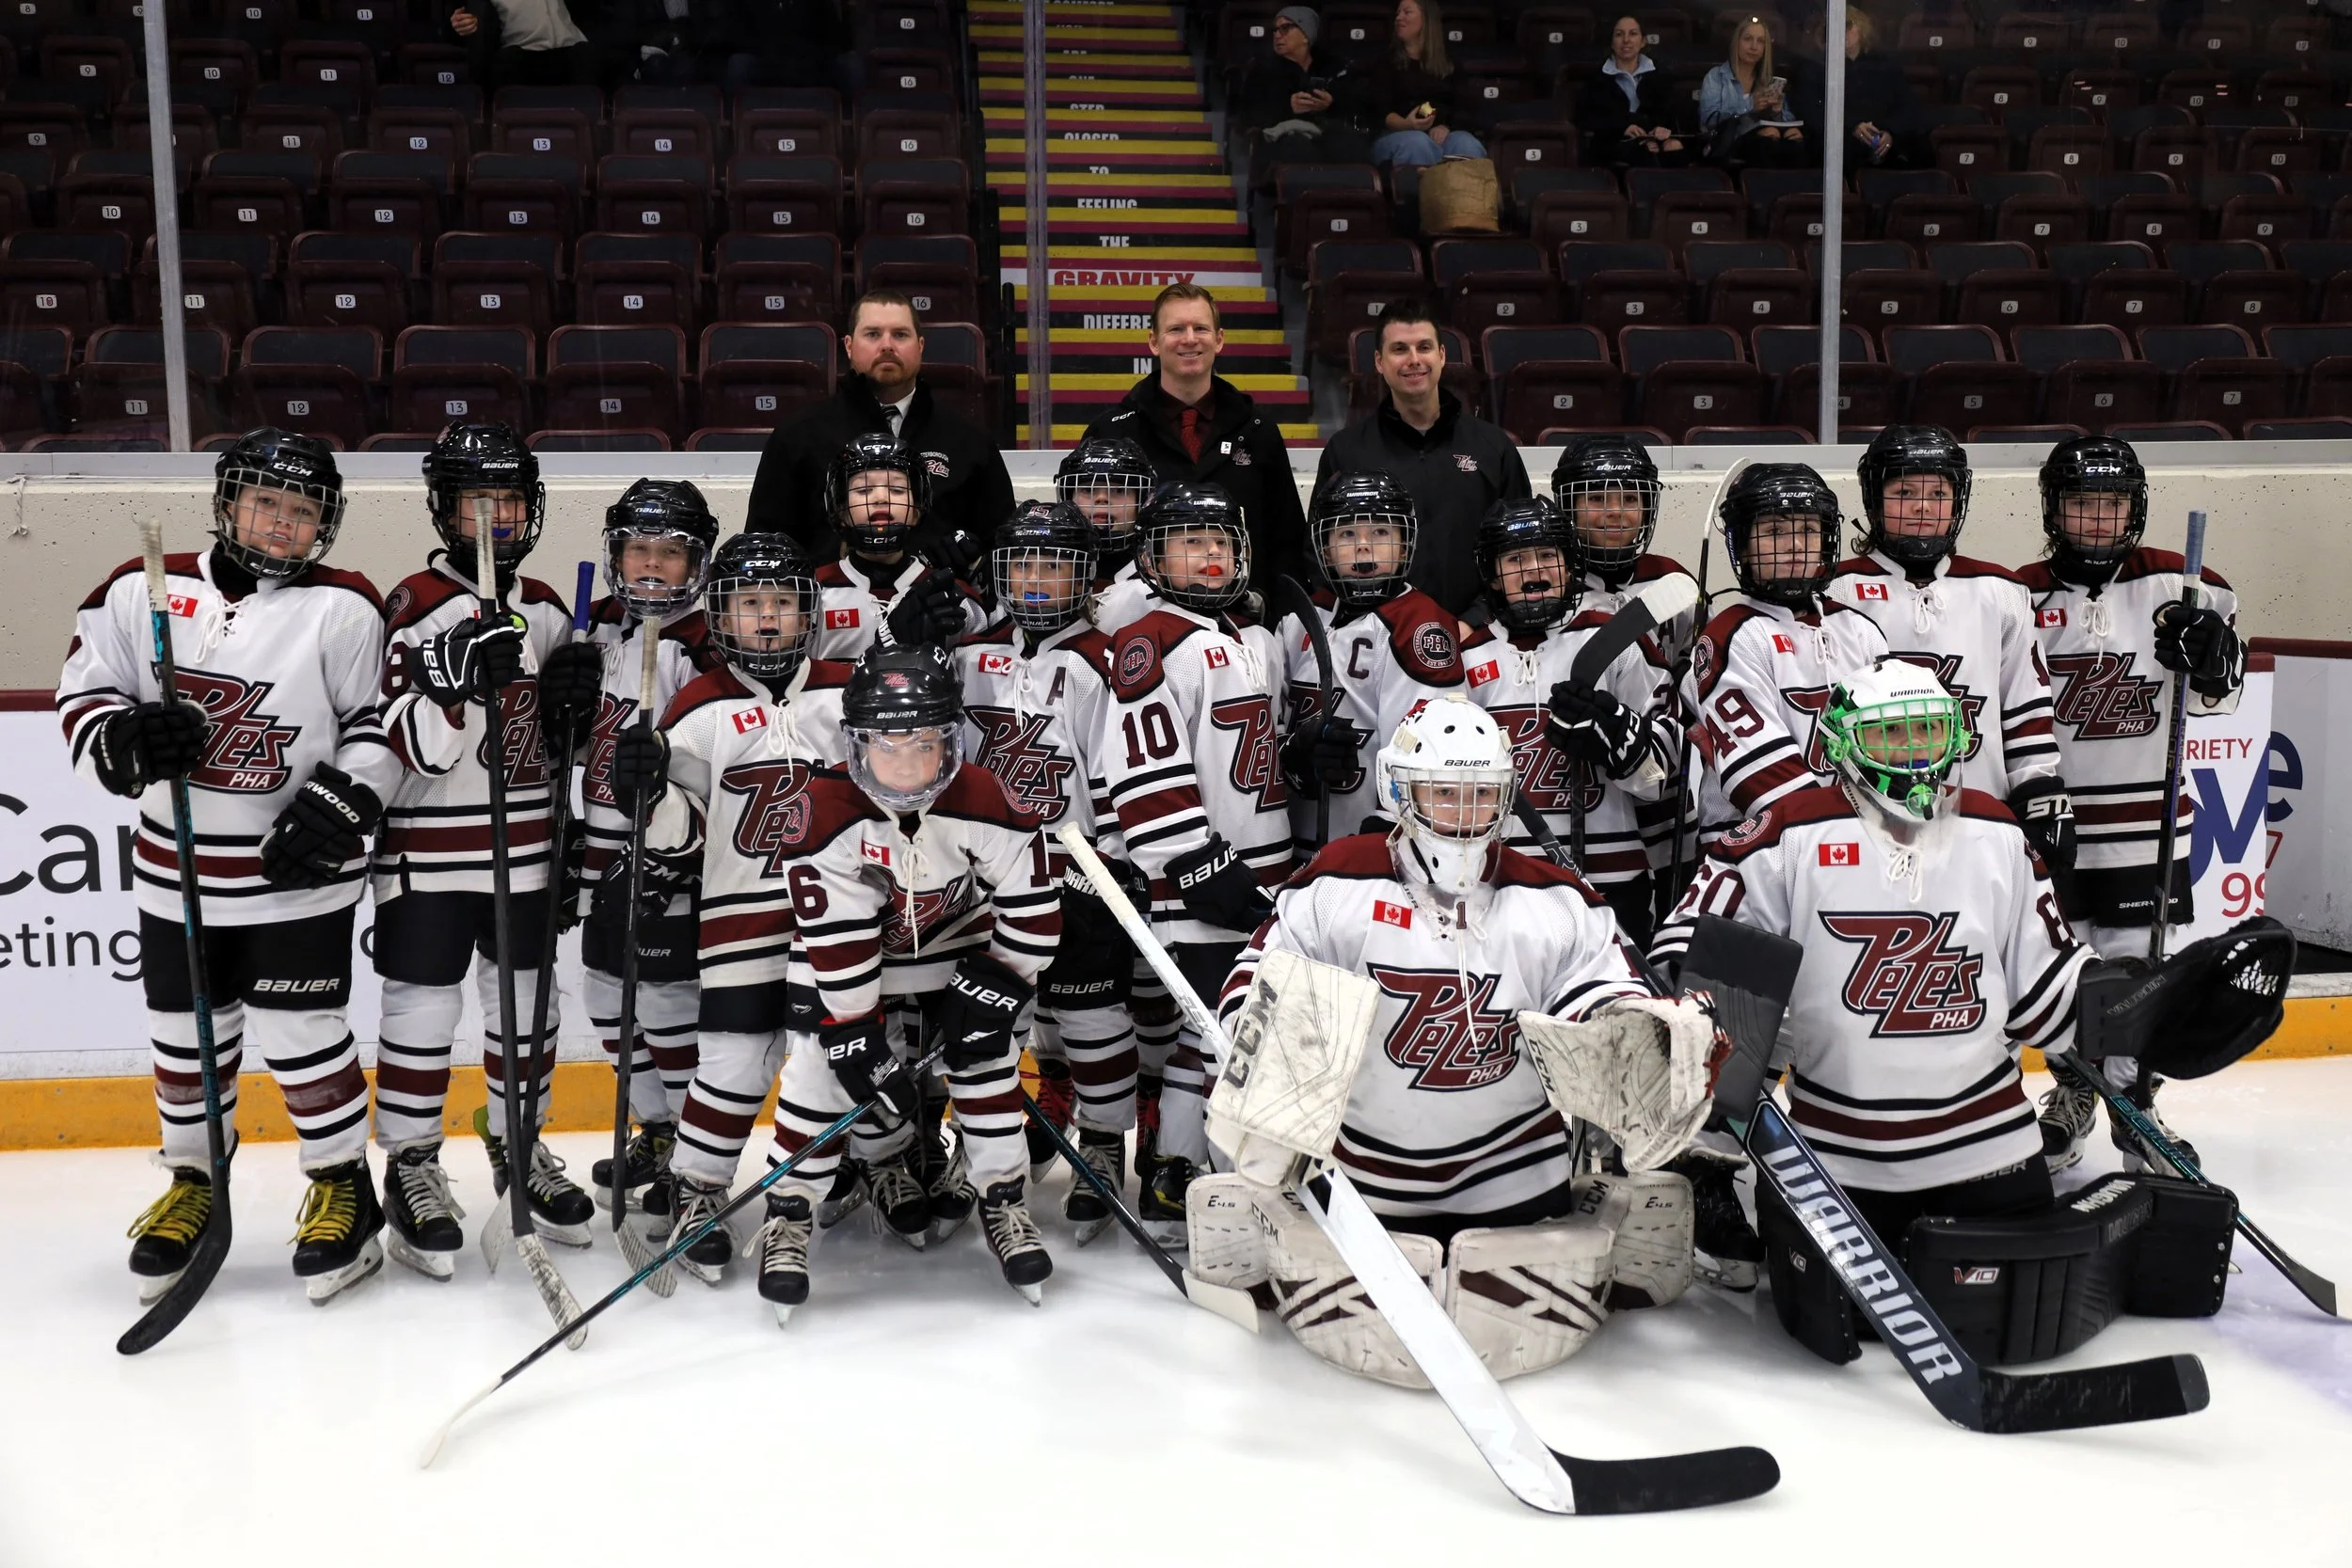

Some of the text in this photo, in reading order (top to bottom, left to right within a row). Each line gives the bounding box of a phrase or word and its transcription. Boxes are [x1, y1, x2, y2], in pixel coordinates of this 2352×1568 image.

[1100, 235, 1129, 247] THE
[1054, 270, 1195, 286] GRAVITY
[1084, 314, 1152, 329] DIFFERE
[1133, 357, 1152, 374] IN
[920, 451, 949, 464] TERBOROUGH
[1908, 448, 1945, 456] BAUER
[273, 461, 312, 476] CCM
[482, 461, 518, 470] BAUER
[1596, 463, 1632, 471] BAUER
[2085, 466, 2122, 474] CCM
[1346, 490, 1379, 499] WARRIOR
[1507, 520, 1539, 531] BAUER
[745, 560, 781, 570] CCM
[1423, 634, 1451, 653] PHA
[422, 636, 449, 689] BAU
[1346, 637, 1373, 680] C
[1045, 666, 1067, 706] A
[1890, 688, 1935, 698] WARRIOR
[876, 710, 918, 720] BAUER
[1121, 701, 1180, 769] 10
[2116, 720, 2145, 734] PHA
[2183, 737, 2254, 761] RIETY
[1444, 758, 1491, 768] BAUER
[228, 771, 272, 789] PHA
[596, 784, 617, 802] PH
[303, 781, 360, 824] RWOOD
[1179, 846, 1238, 890] BAUE
[787, 864, 829, 921] 6
[1402, 881, 1419, 910] UER
[2119, 897, 2179, 910] SHER-OD
[1455, 901, 1468, 930] 1
[637, 947, 672, 958] UER
[253, 976, 341, 993] BAUER
[949, 970, 1020, 1012] AUER
[1049, 979, 1115, 994] BAUER
[1929, 1008, 1970, 1030] PHA
[1223, 977, 1279, 1089] CCM
[1529, 1037, 1555, 1093] CCM
[1466, 1064, 1502, 1085] PHA
[1578, 1180, 1610, 1215] CCM
[1769, 1145, 1964, 1386] WARRIOR
[1953, 1266, 2001, 1286] V10
